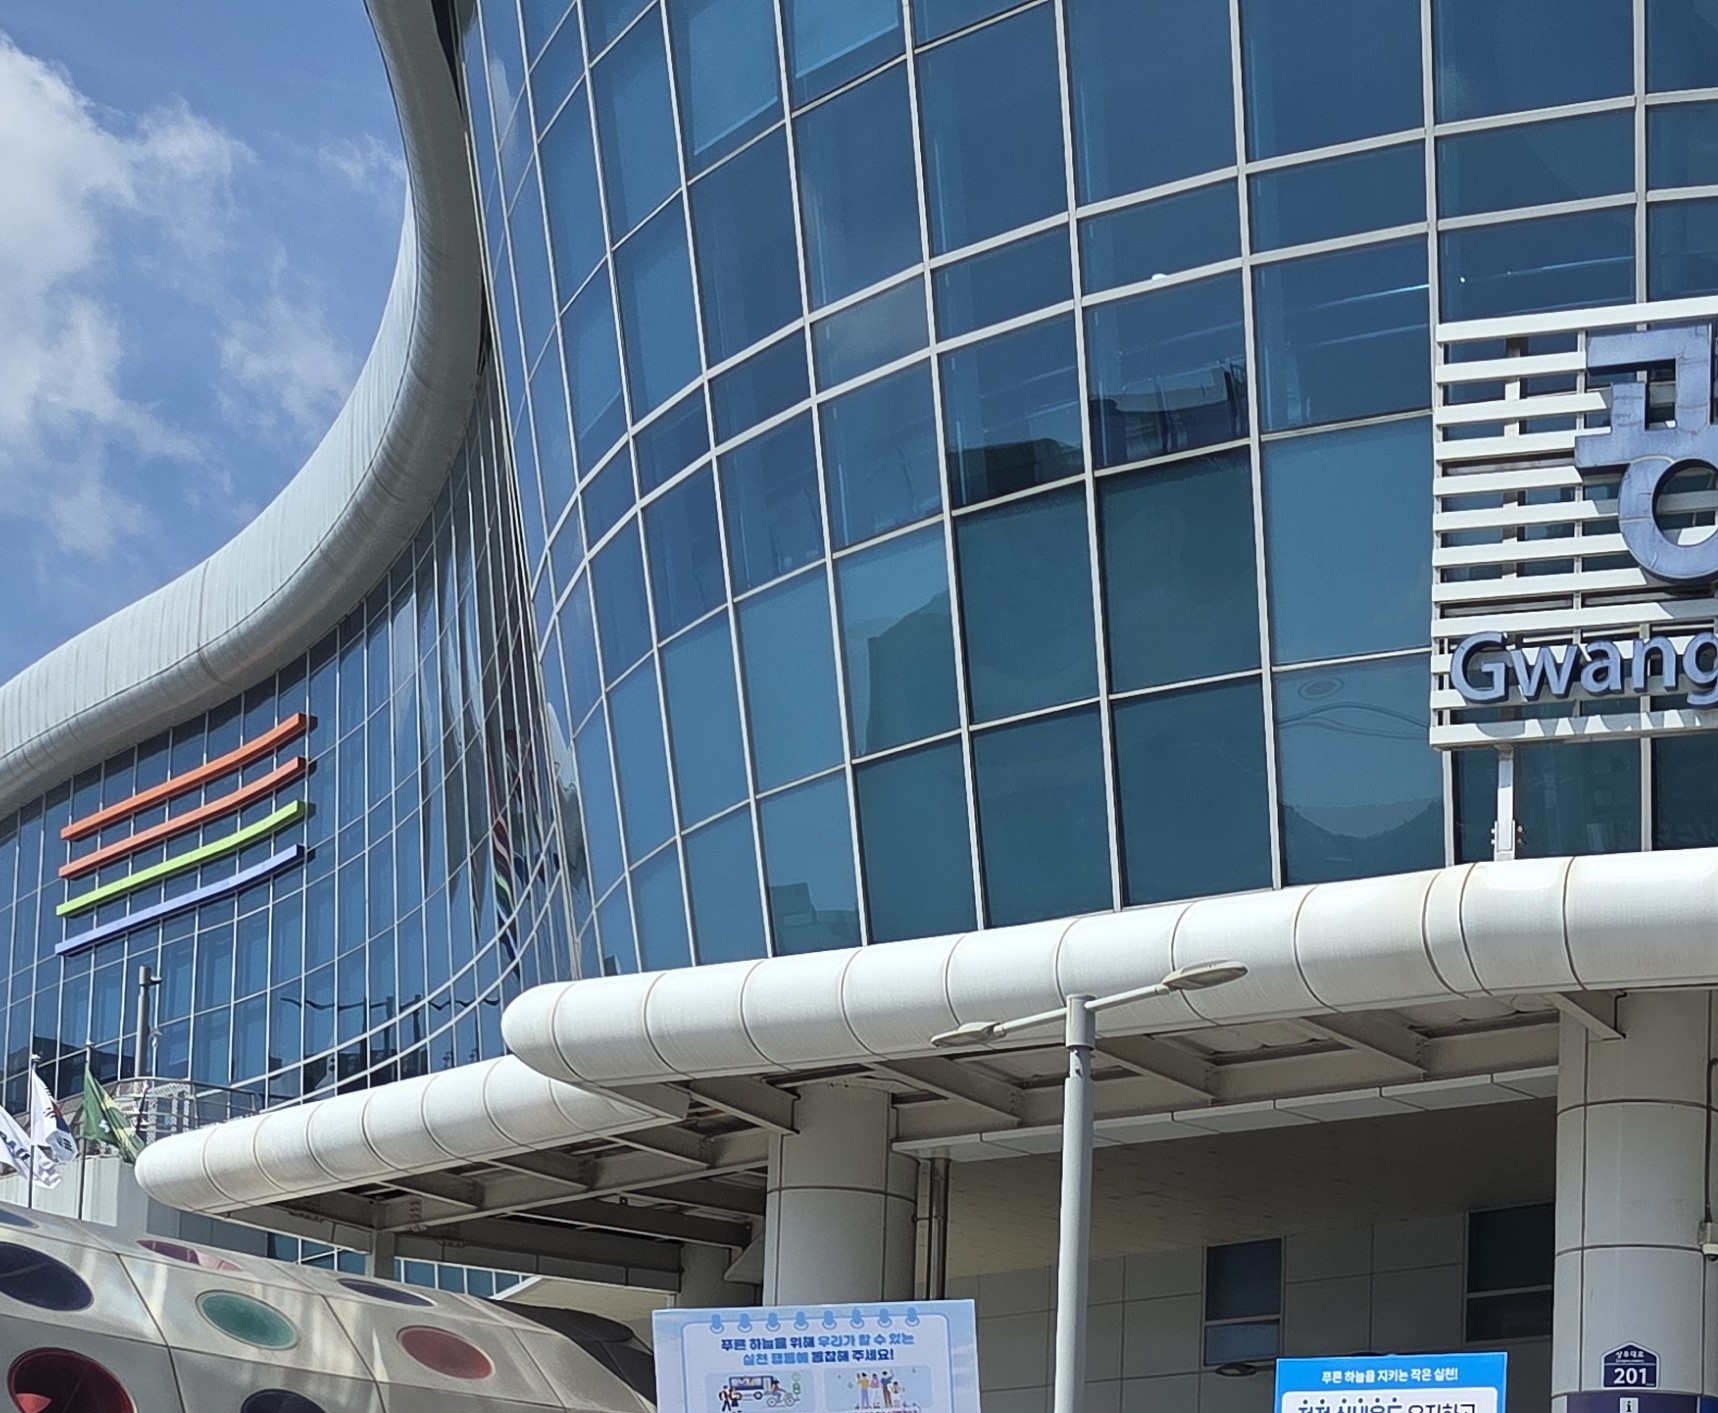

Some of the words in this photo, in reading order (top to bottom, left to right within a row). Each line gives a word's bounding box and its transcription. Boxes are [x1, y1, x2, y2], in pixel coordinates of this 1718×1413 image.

[720, 1338, 747, 1351] 푸른
[748, 1336, 788, 1351] 하늘을
[790, 1336, 815, 1349] 위해
[817, 1334, 856, 1347] 우리가
[858, 1333, 871, 1346] 할
[873, 1333, 887, 1346] 수
[889, 1332, 915, 1345] 있는
[742, 1352, 768, 1366] 실천
[851, 1348, 895, 1362] 주세요!
[1321, 1370, 1342, 1384] 푸른
[1344, 1369, 1375, 1383] 하늘을
[1377, 1368, 1409, 1383] 지키는
[1410, 1367, 1432, 1382] 작은
[1434, 1366, 1459, 1382] 실천!
[1613, 1367, 1647, 1385] 201
